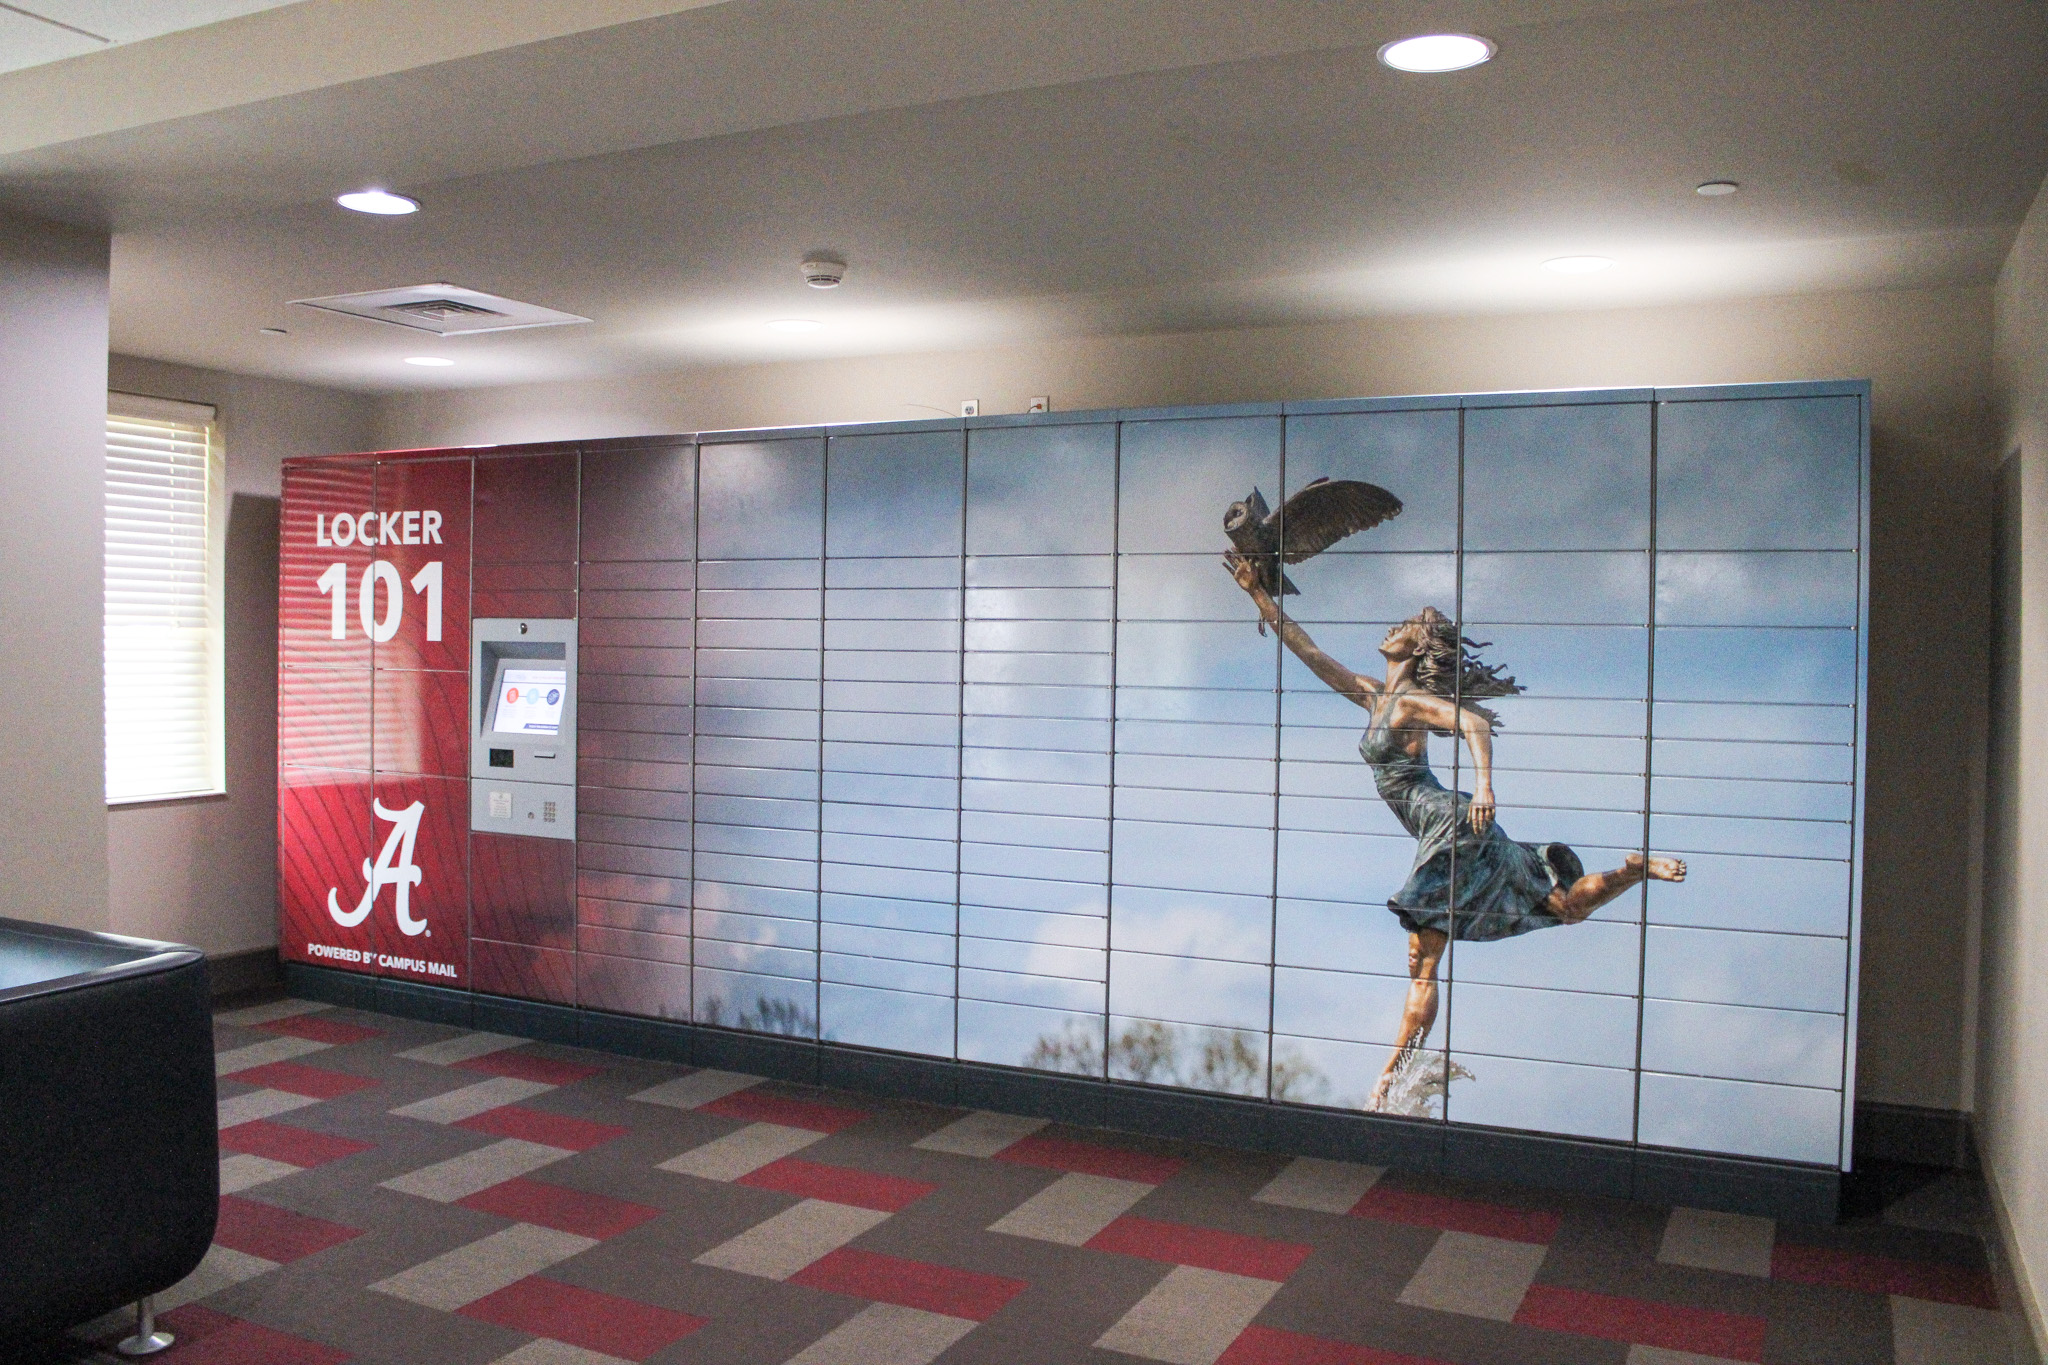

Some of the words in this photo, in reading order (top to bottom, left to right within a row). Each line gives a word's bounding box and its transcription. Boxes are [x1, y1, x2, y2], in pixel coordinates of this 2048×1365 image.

[316, 510, 443, 547] LOCKER
[316, 560, 443, 643] 101
[307, 943, 361, 962] POWERED
[378, 954, 426, 973] CAMPUS
[428, 962, 457, 978] MAIL
